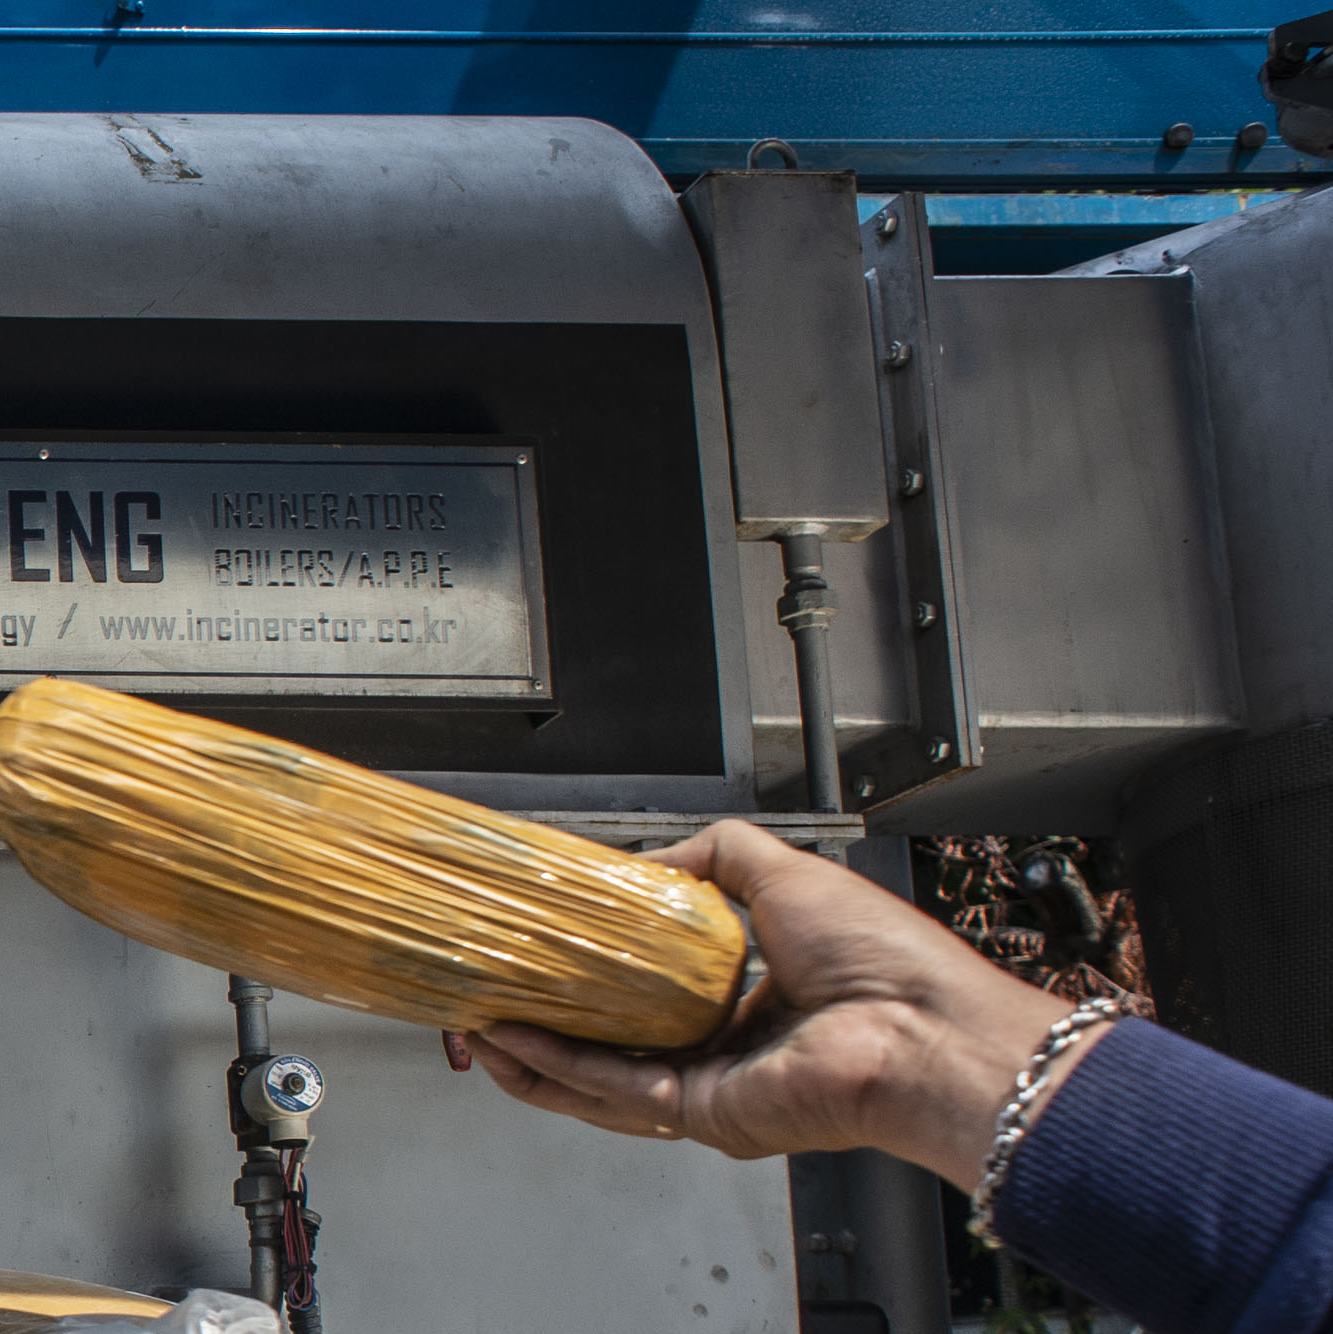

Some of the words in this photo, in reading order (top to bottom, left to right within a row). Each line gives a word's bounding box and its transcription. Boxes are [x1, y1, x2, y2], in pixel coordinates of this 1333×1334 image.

[211, 492, 446, 530] INCINERATORS
[7, 489, 165, 584] ENG
[99, 605, 457, 643] www.incinerator.co.kr
